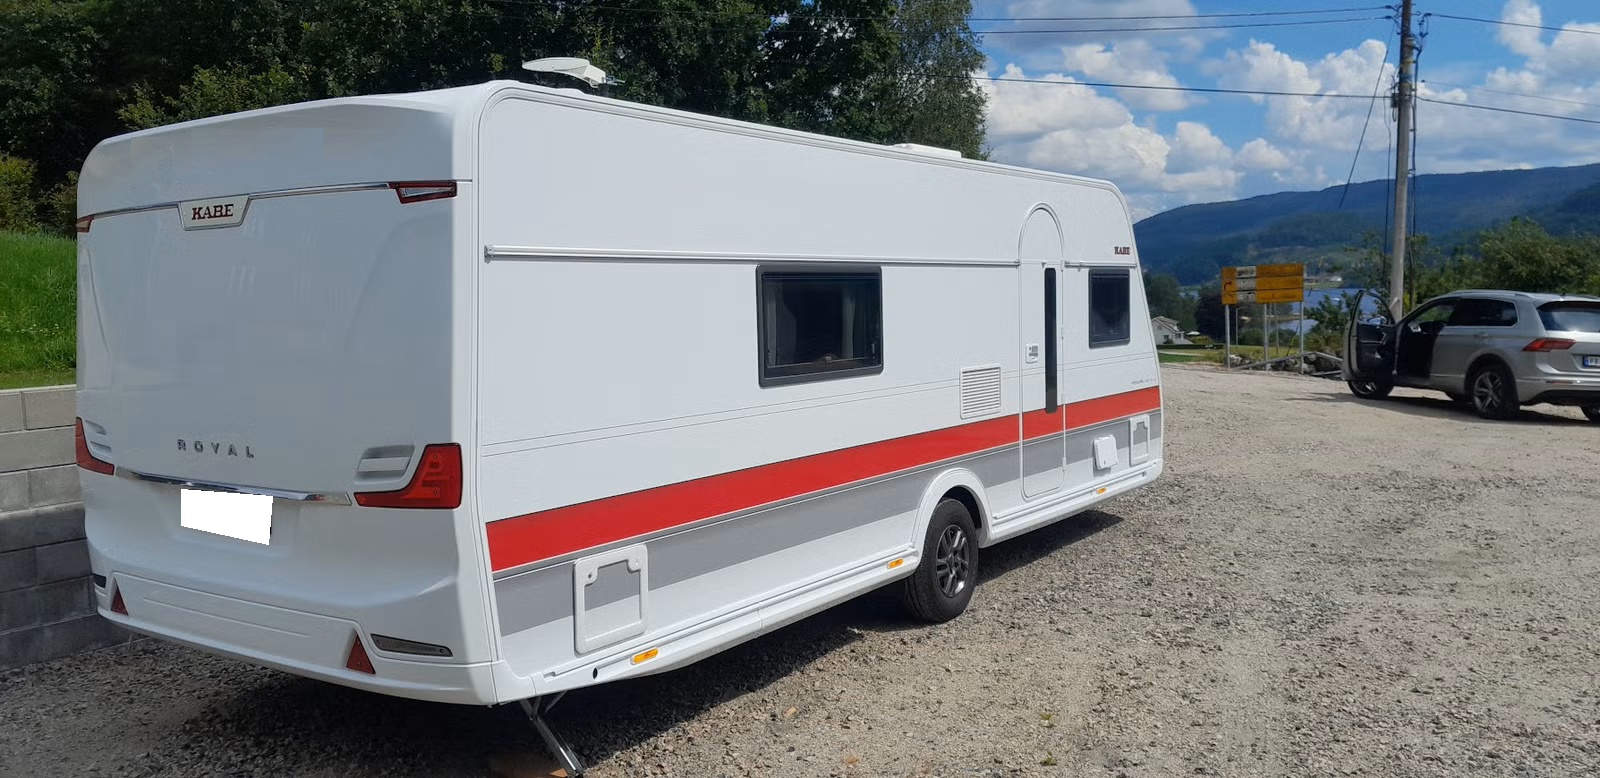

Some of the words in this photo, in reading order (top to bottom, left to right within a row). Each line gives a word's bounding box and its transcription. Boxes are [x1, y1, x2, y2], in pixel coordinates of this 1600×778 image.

[191, 203, 234, 221] KABE
[1114, 246, 1131, 256] KABE
[177, 438, 255, 459] ROYAL
